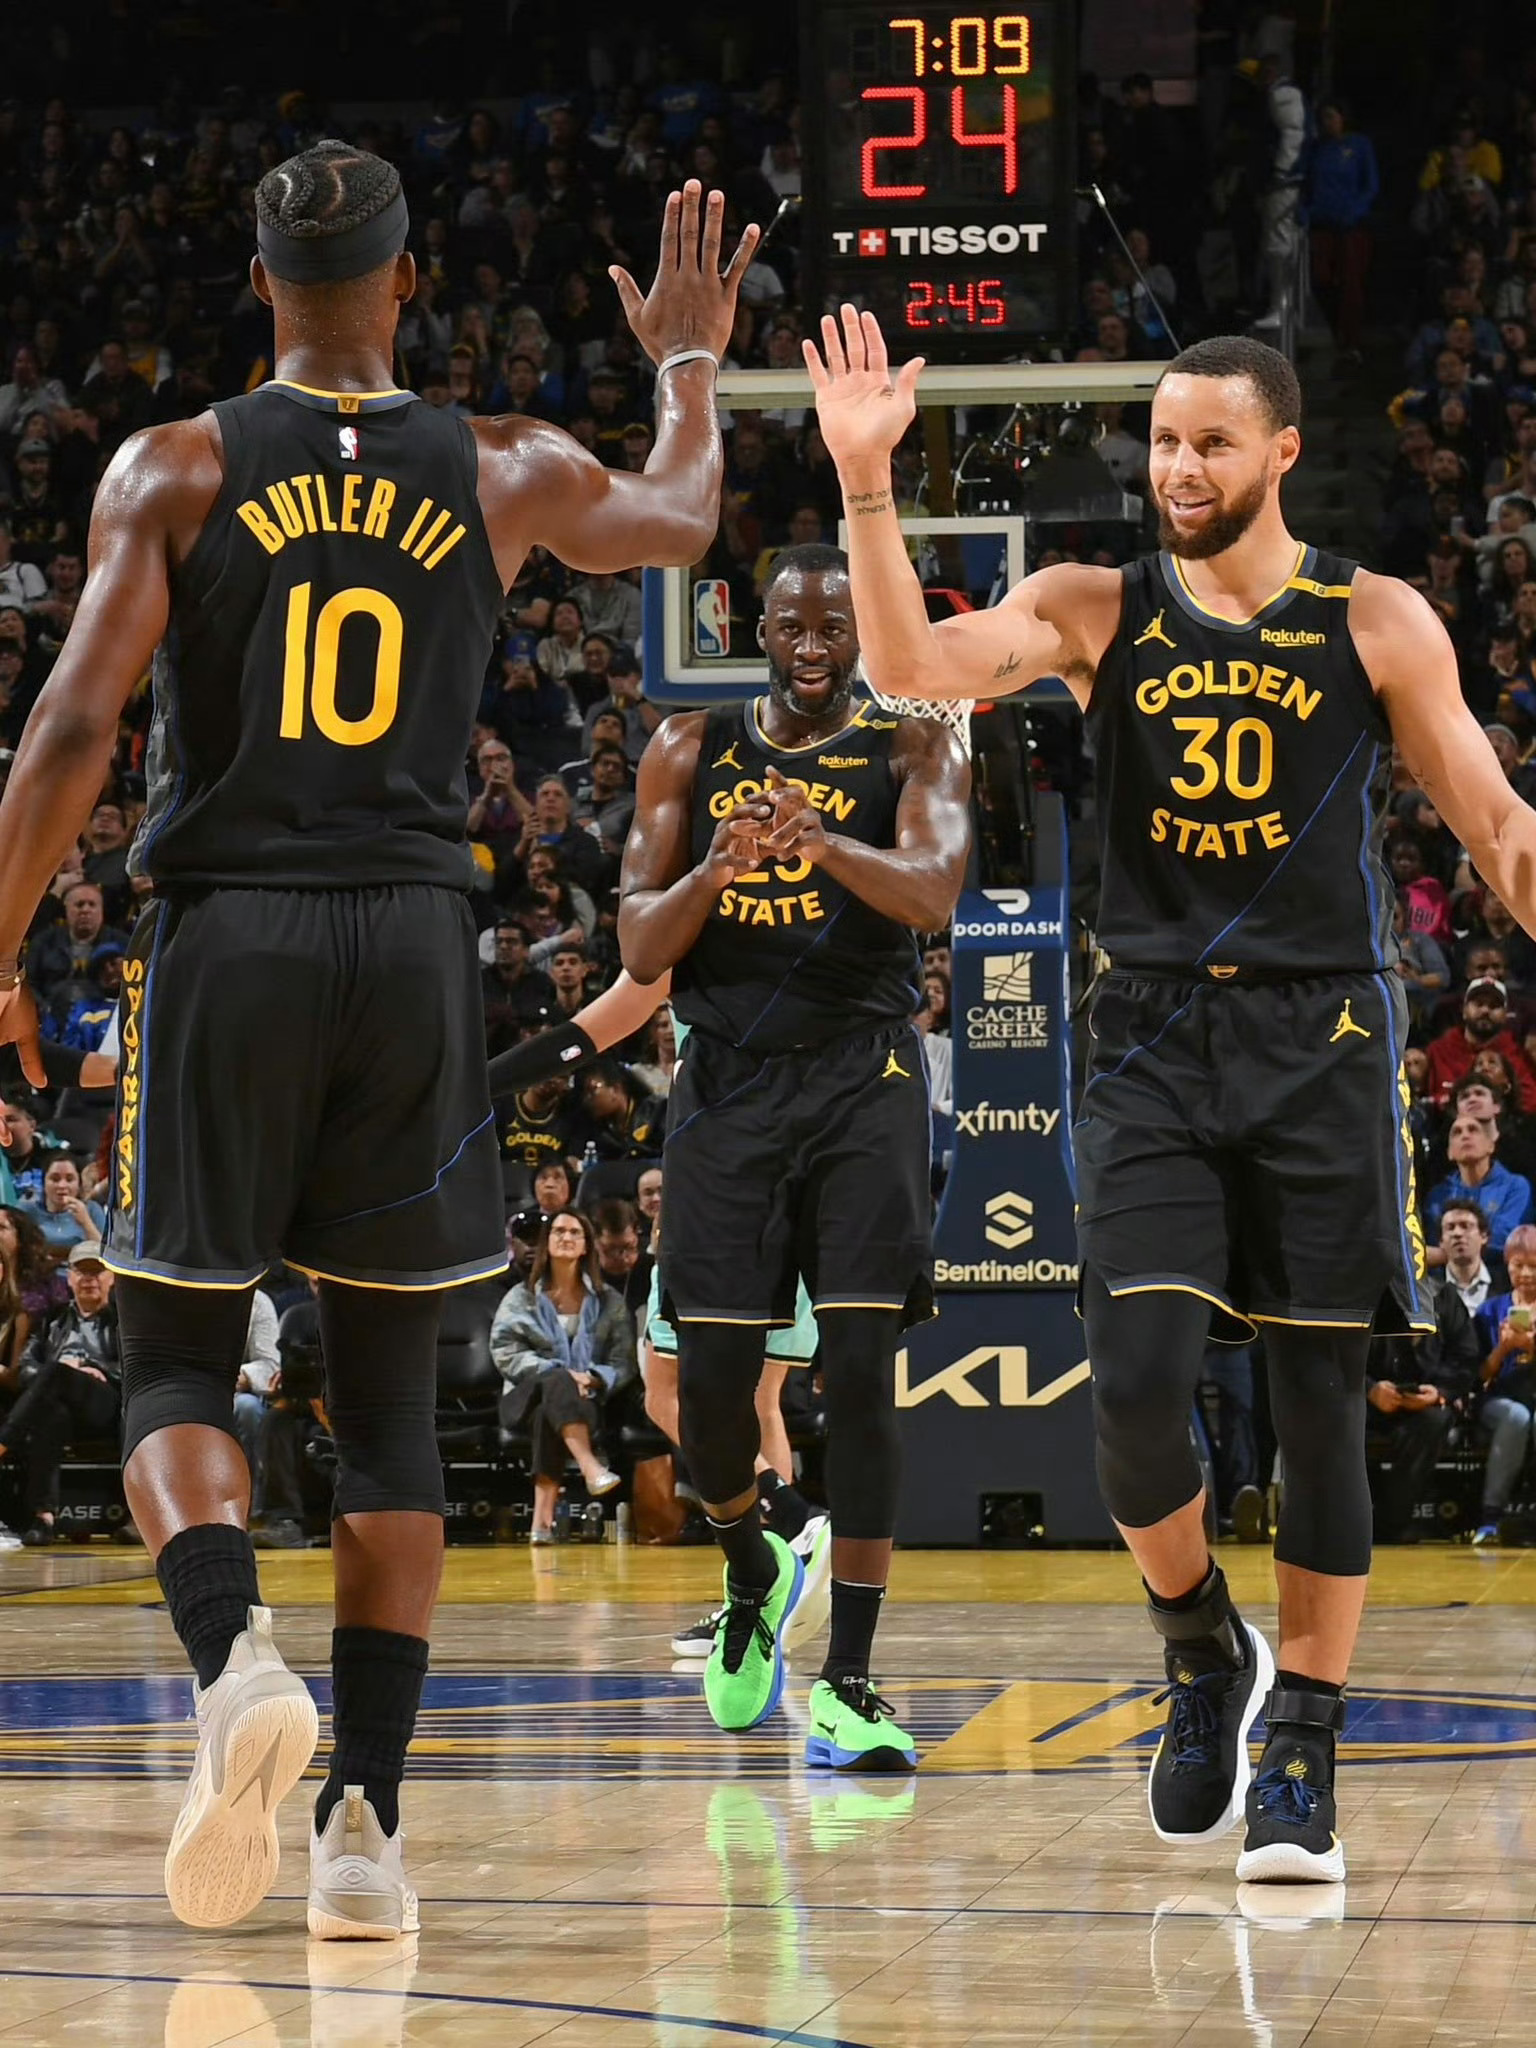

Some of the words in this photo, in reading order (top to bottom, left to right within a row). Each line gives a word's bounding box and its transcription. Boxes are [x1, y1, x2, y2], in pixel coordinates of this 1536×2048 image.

[889, 16, 1029, 77] 7:09
[861, 84, 1018, 198] 24
[890, 224, 1048, 255] TISSOT
[906, 280, 1005, 327] 2:45
[236, 474, 397, 555] BUTLER
[399, 497, 467, 571] III
[1260, 628, 1326, 647] Rakuten
[280, 581, 404, 746] 10
[1135, 660, 1323, 721] GOLDEN
[818, 755, 868, 768] Rakuten
[1170, 717, 1273, 800] 30
[1151, 808, 1290, 859] STATE
[719, 889, 825, 926] STATE
[954, 921, 1062, 936] DOORDASH
[967, 1005, 1048, 1023] CACHE
[967, 1022, 1048, 1040] CREEK
[968, 1040, 1007, 1049] CASINO
[1011, 1039, 1048, 1049] RESORT
[117, 958, 144, 1210] WARRIORS
[955, 1101, 1061, 1136] xfinity
[506, 1132, 562, 1151] GOLDEN
